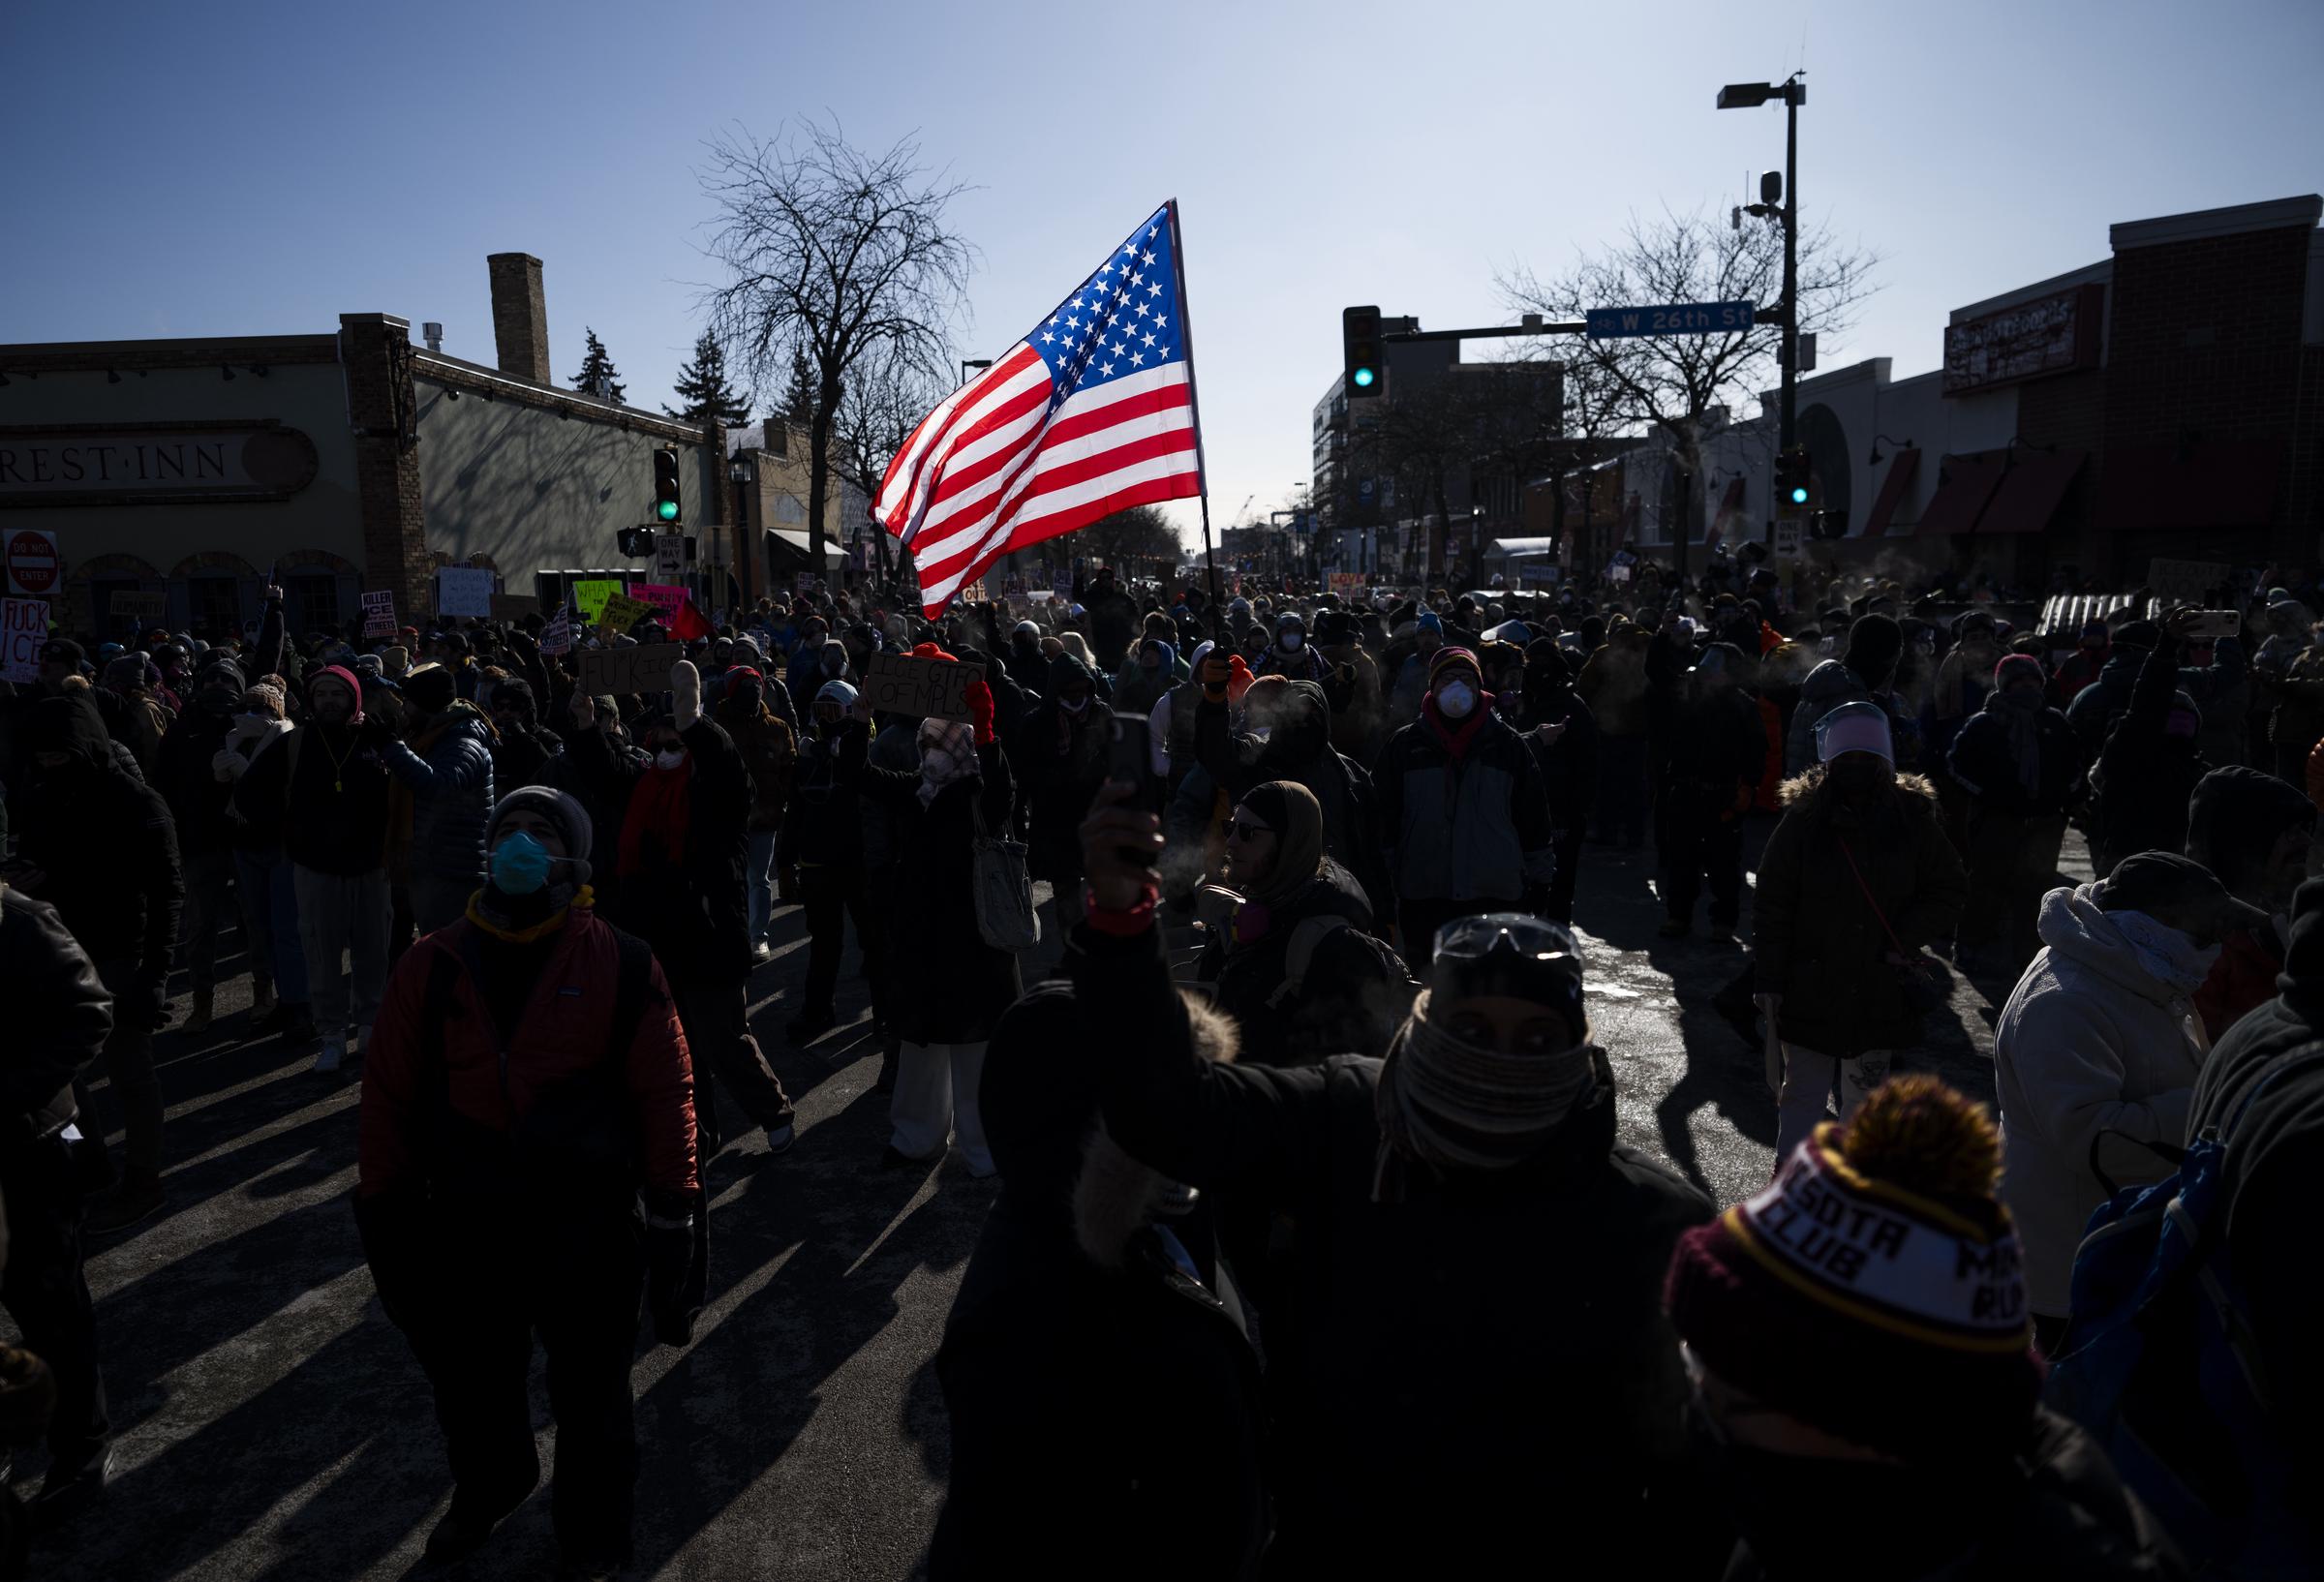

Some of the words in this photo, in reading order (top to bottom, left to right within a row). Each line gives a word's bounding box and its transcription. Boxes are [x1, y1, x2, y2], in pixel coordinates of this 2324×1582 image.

[1621, 313, 1640, 332] W
[1652, 310, 1710, 330] 26th
[1721, 307, 1749, 326] St
[1779, 522, 1800, 532] ONE
[1779, 532, 1799, 541] WAY
[14, 542, 26, 554] DO
[31, 543, 49, 554] NOT
[660, 538, 681, 548] ONE
[660, 549, 681, 559] WAY
[19, 570, 49, 581] ENTER
[1330, 573, 1364, 584] LOVE
[577, 581, 612, 597] WHAT
[965, 590, 986, 600] OUT
[363, 593, 391, 605] KILLER
[5, 599, 48, 632] FUCK
[365, 620, 396, 631] STREETS
[3, 632, 46, 665] ICE
[873, 655, 919, 680] ICE
[928, 661, 982, 687] GTFO
[879, 682, 912, 705] OF
[1757, 1200, 1867, 1281] CLUB
